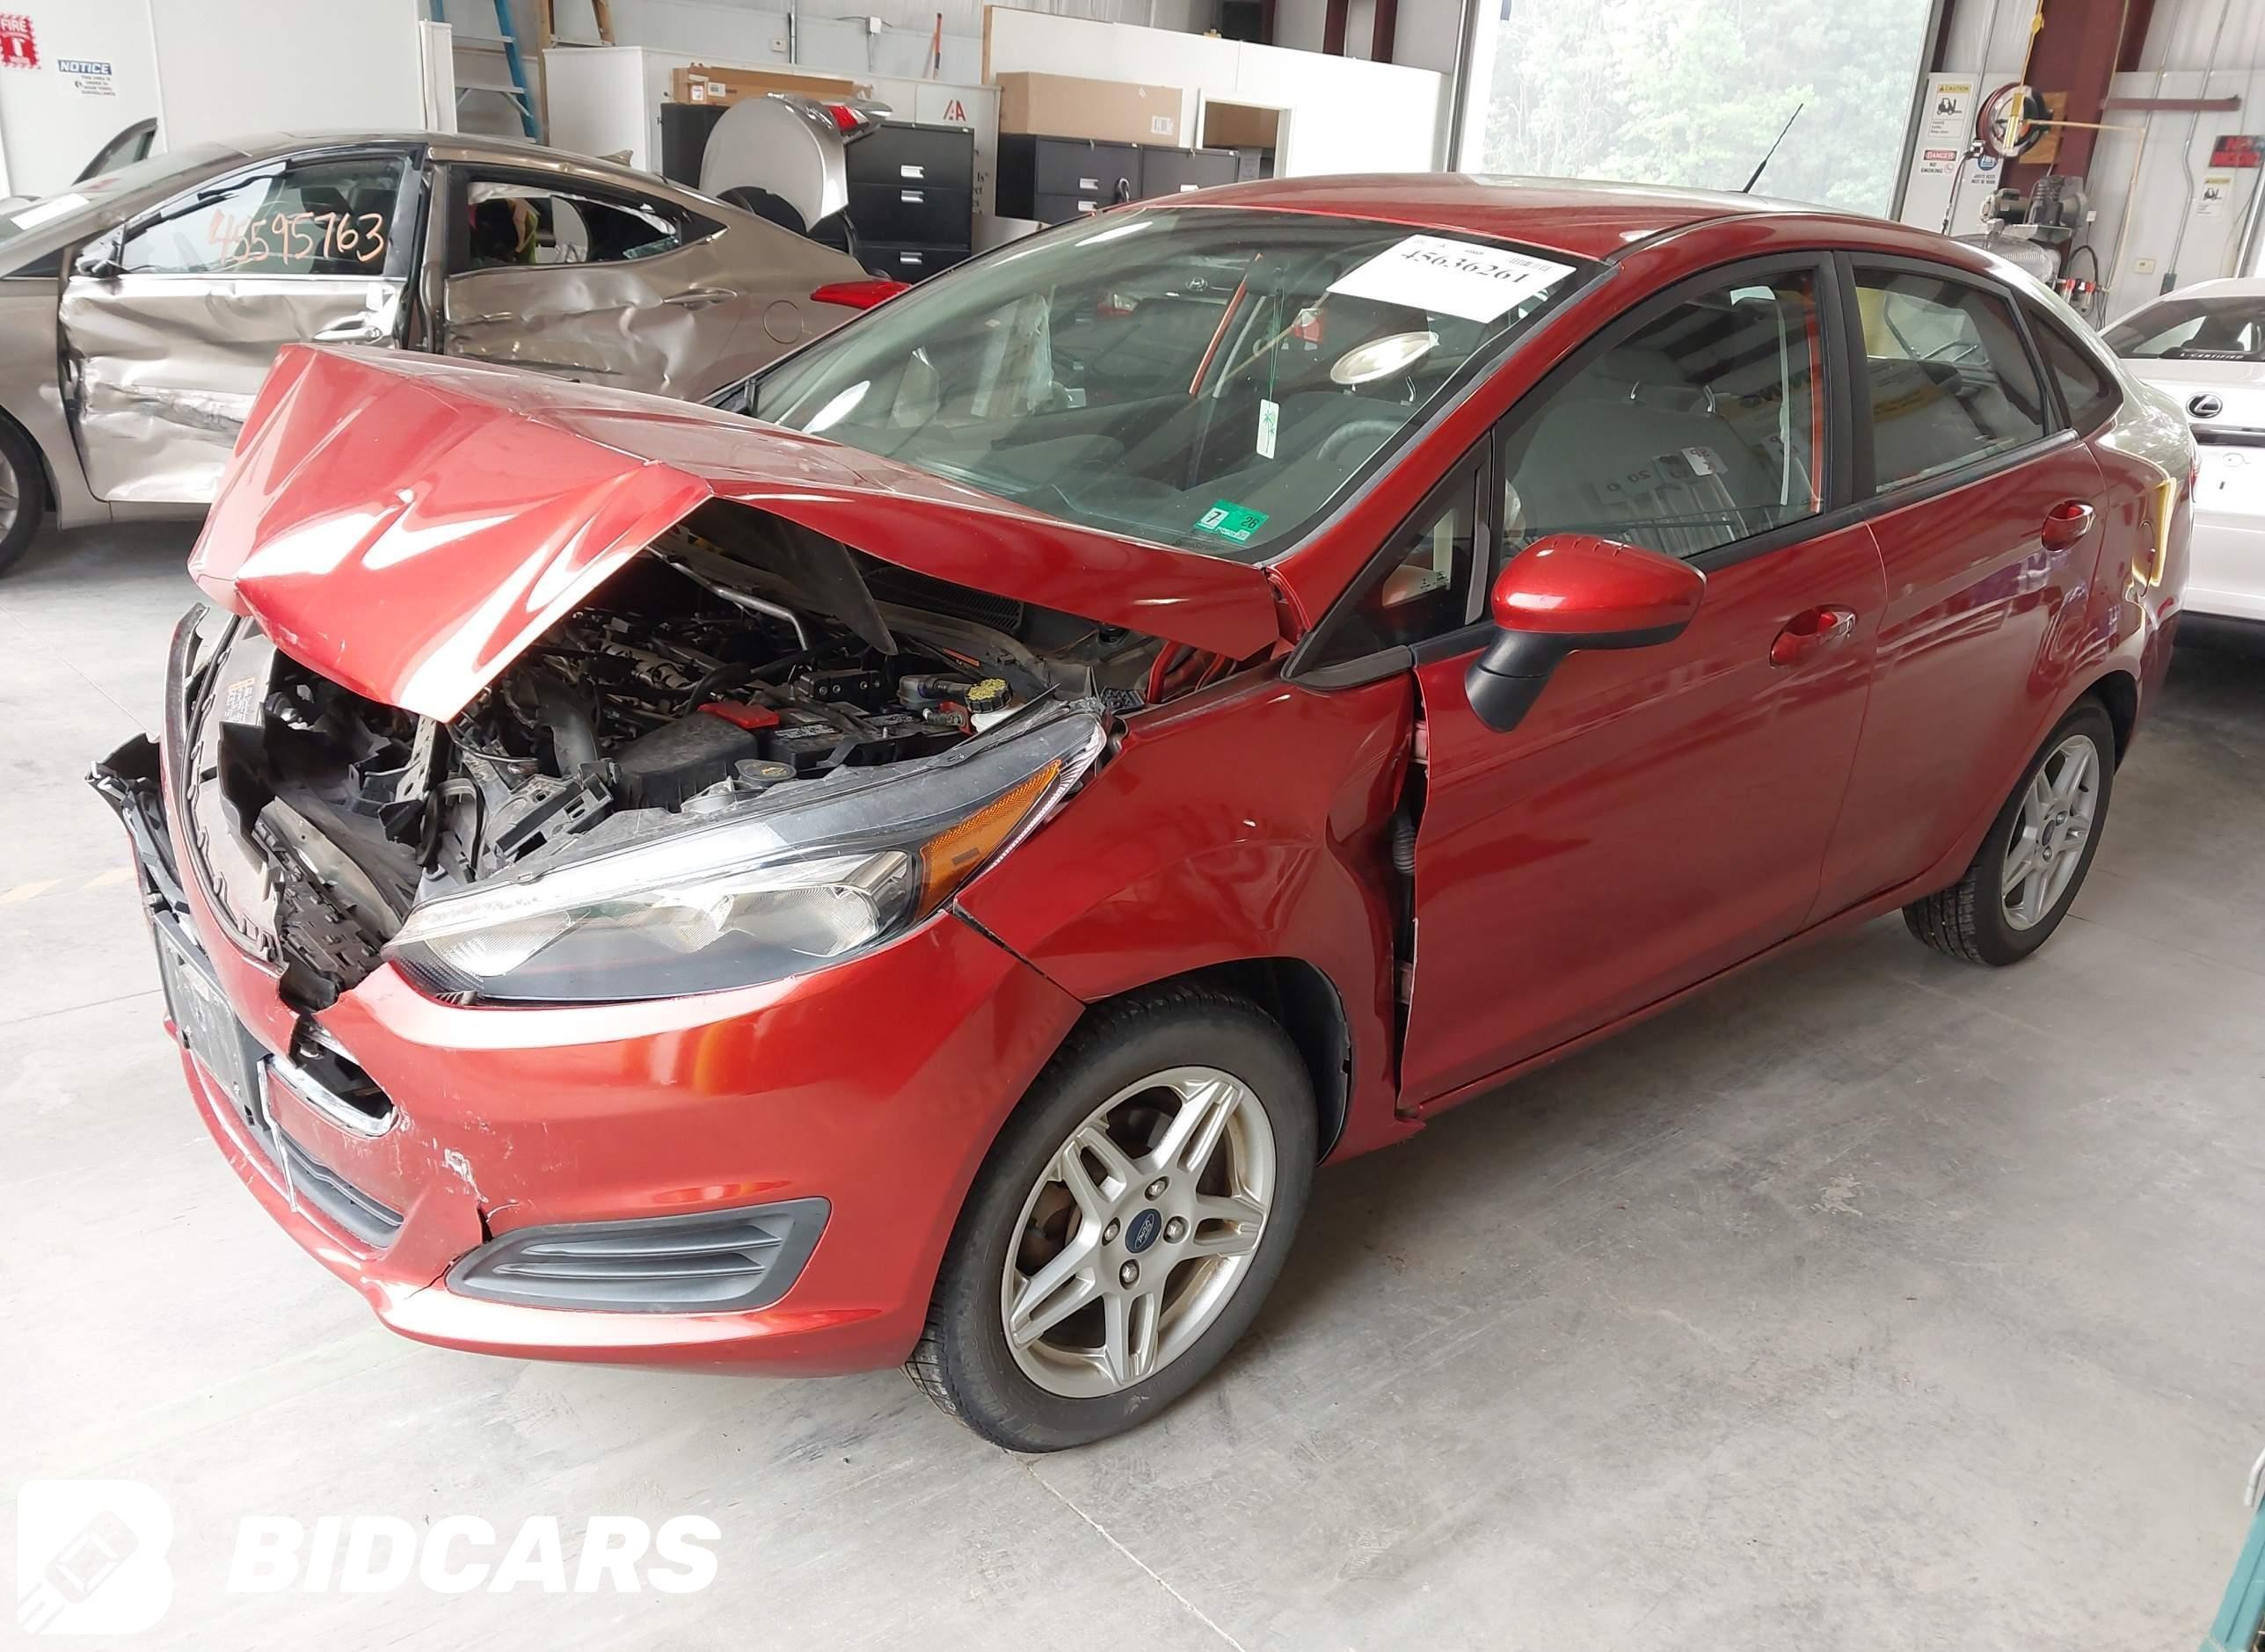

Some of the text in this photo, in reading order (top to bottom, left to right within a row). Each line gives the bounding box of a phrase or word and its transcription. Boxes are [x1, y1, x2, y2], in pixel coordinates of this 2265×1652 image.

[2, 18, 27, 32] FIRE
[60, 61, 109, 74] NOTICE
[1241, 516, 1260, 529] 26
